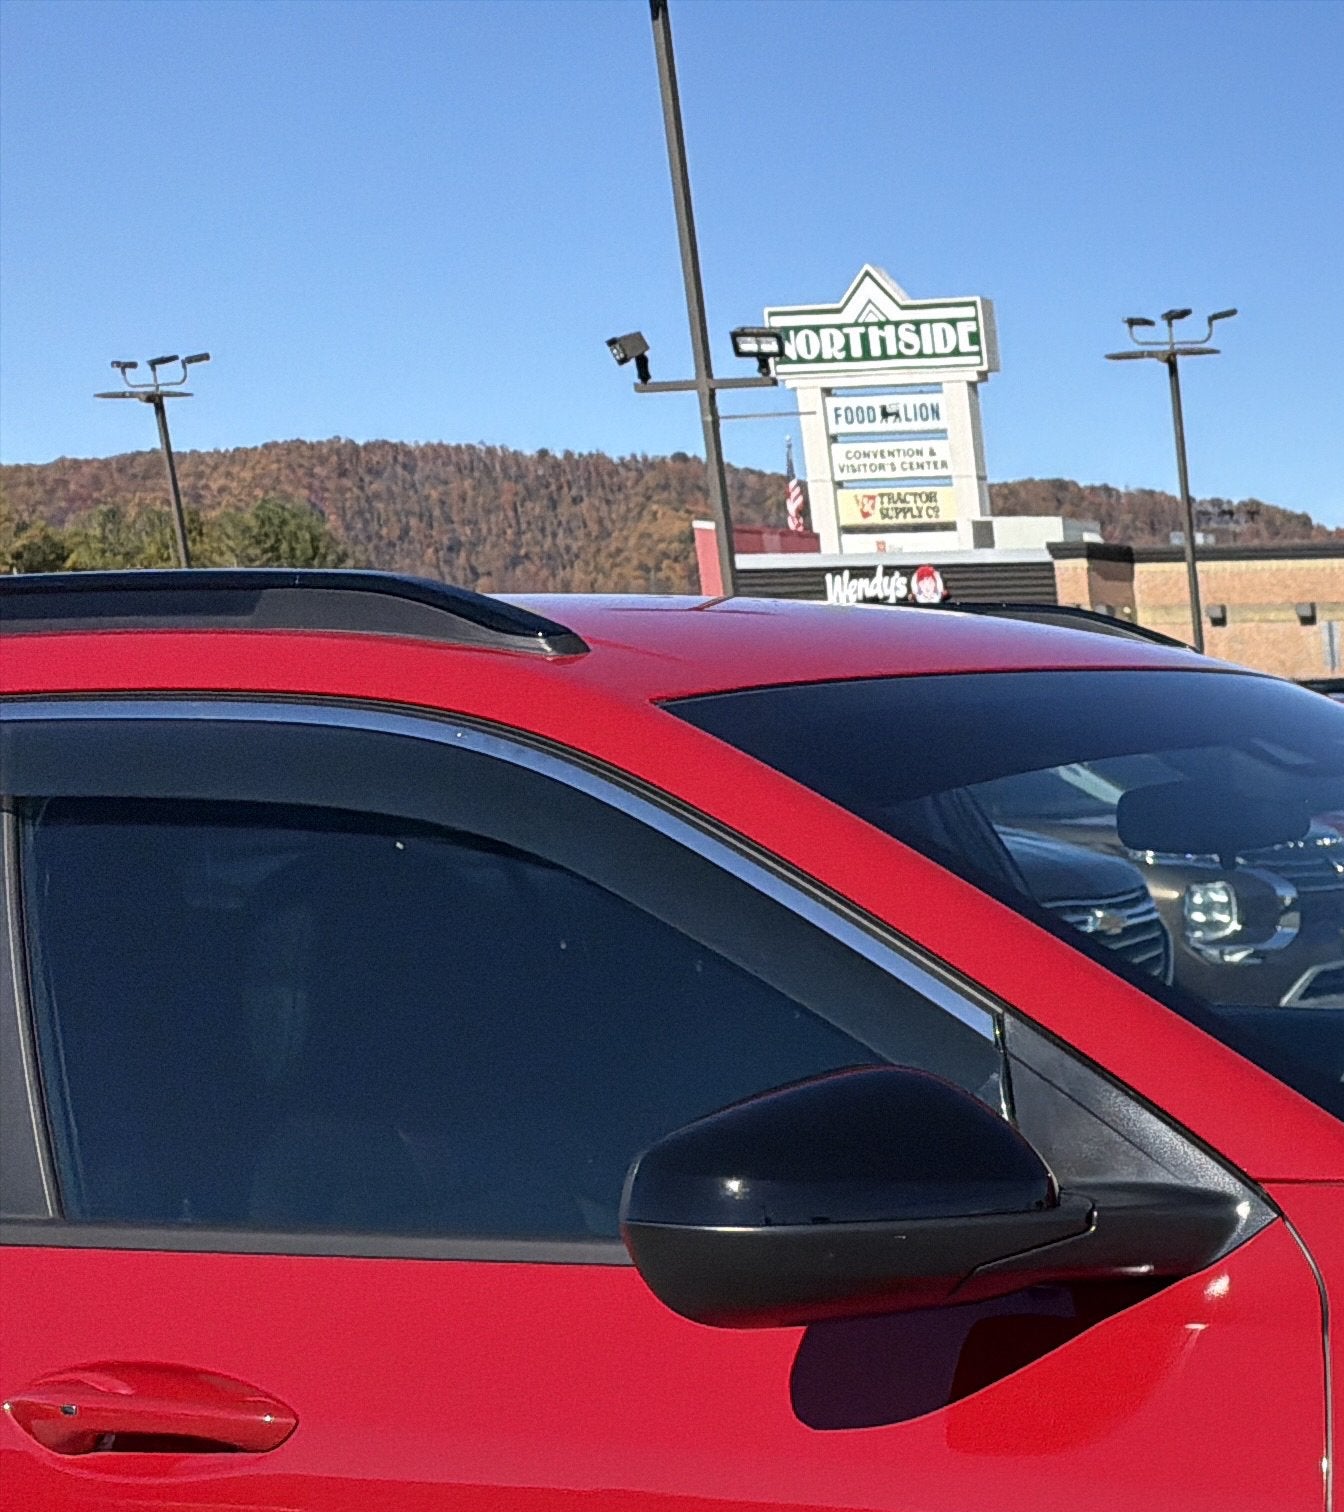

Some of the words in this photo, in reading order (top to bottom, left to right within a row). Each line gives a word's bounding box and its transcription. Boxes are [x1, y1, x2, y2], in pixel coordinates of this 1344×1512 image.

[783, 320, 980, 361] NORTHSIDE
[834, 405, 877, 425] FOOD
[903, 402, 941, 422] LION
[845, 447, 923, 460] CONVENTION
[838, 461, 897, 474] VISITOR'S
[900, 459, 948, 471] CENTER
[878, 491, 938, 505] TRACTOR
[879, 506, 924, 520] SUPPLY
[825, 564, 908, 604] Wendy's
